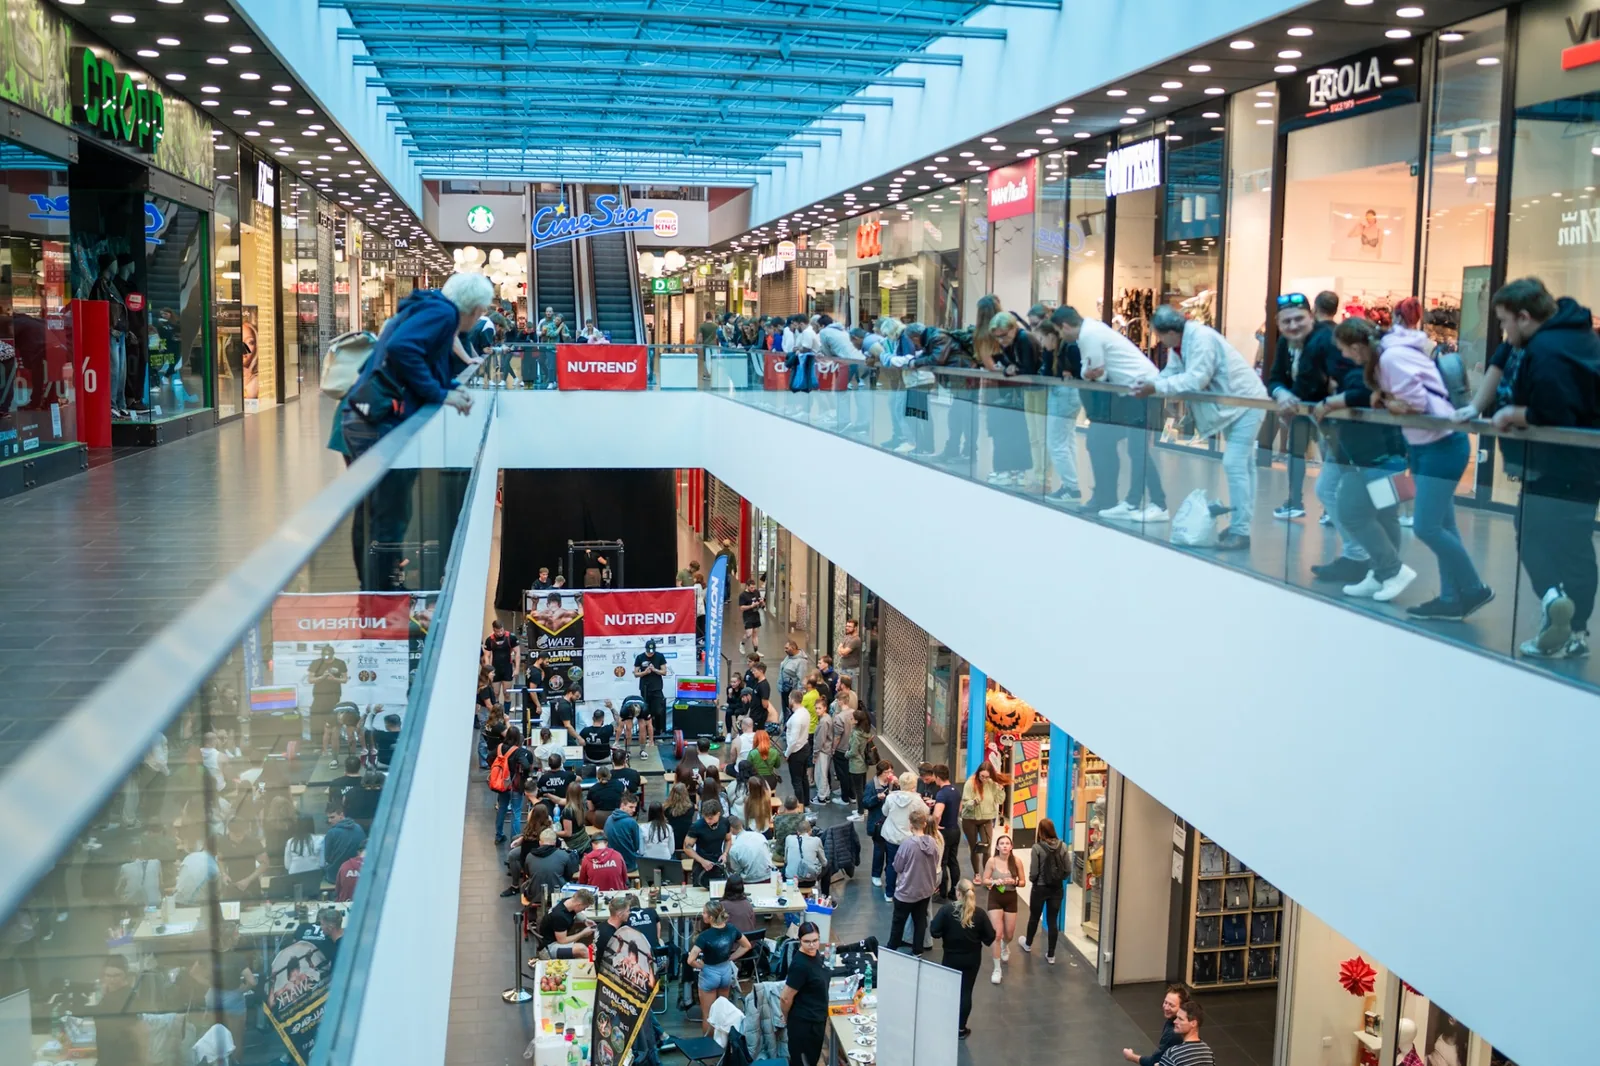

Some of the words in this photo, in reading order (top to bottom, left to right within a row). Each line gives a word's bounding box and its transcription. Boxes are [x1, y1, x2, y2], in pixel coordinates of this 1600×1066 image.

[83, 46, 164, 155] CROPP
[655, 279, 666, 291] D
[567, 359, 638, 373] NUTREND
[604, 612, 677, 626] NUTREND
[708, 575, 720, 677] DECTHLON
[547, 637, 576, 648] WAFK
